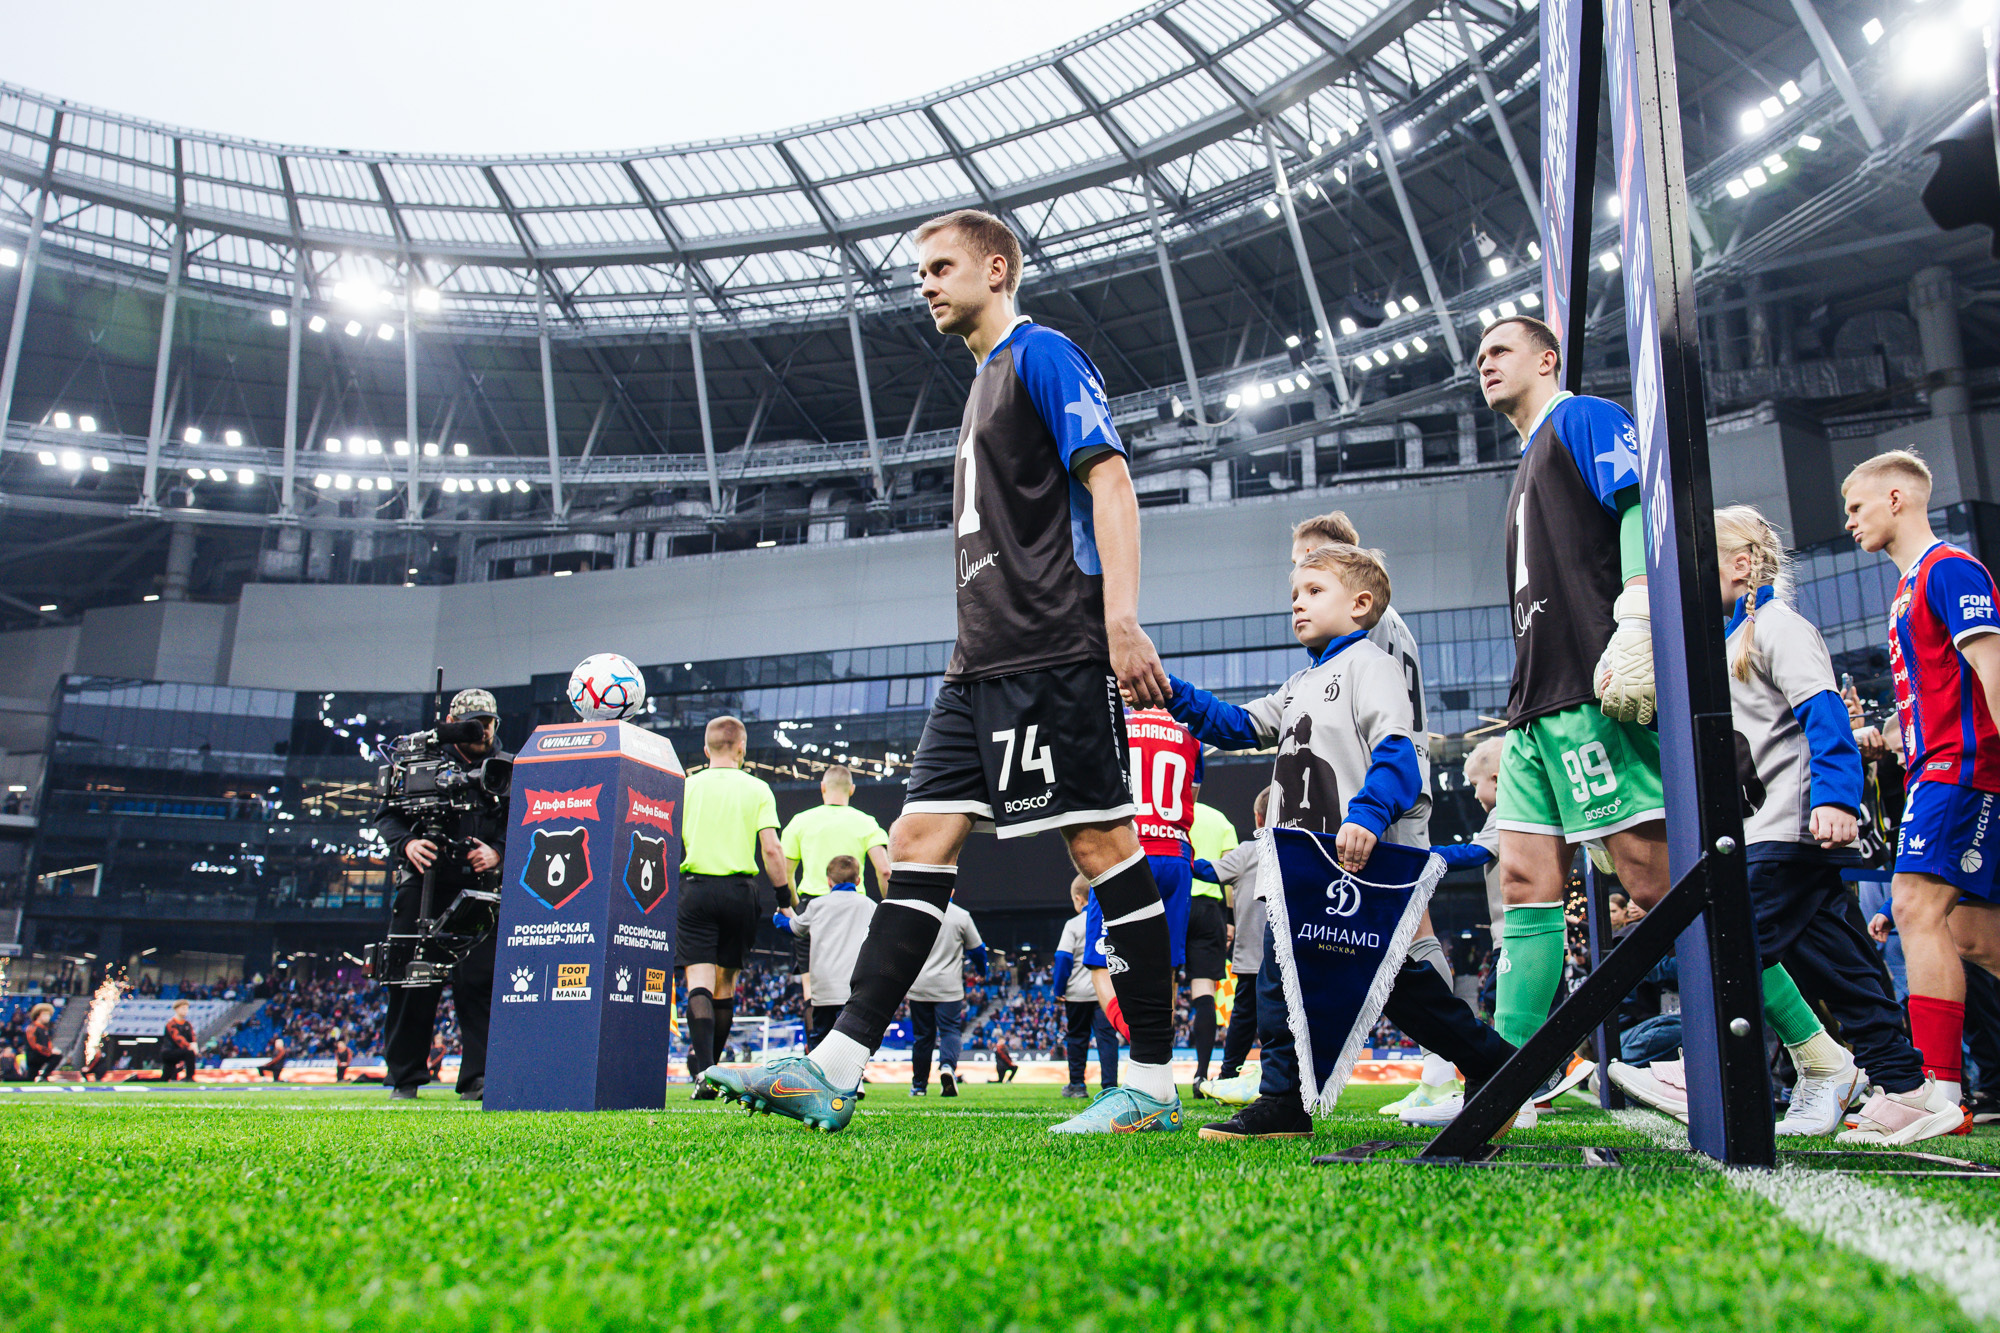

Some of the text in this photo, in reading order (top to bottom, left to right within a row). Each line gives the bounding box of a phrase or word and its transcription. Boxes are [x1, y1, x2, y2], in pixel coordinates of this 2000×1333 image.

[958, 426, 981, 539] 1
[1959, 594, 1991, 608] FON
[1963, 606, 1994, 620] BET
[542, 735, 592, 749] WINLINE
[992, 724, 1056, 791] 74
[1561, 740, 1618, 803] 99
[1129, 746, 1187, 822] 10
[533, 797, 592, 813] Альфа Банк
[632, 800, 670, 820] Альфа Банк
[1005, 792, 1050, 814] BOSCO
[1585, 800, 1619, 822] BOSCO
[1972, 793, 1994, 847] РОССЕТИ
[514, 921, 590, 935] РОССИЙСКАЯ
[618, 924, 667, 940] РОССИЙСКАЯ
[507, 933, 595, 947] ПРЕМЬЕР-ЛИГА
[613, 934, 669, 951] ПРЕМЬЕР-ЛИГА
[1297, 923, 1380, 948] ДИНАМО
[1318, 943, 1356, 955] МОСКВА
[562, 966, 586, 974] FOOT
[648, 971, 663, 980] FOOT
[561, 978, 583, 987] BALL
[647, 983, 661, 991] BALL
[502, 994, 539, 1003] KELME
[555, 990, 587, 998] MANIA
[609, 993, 634, 1003] KELME
[644, 994, 664, 1003] MANIA
